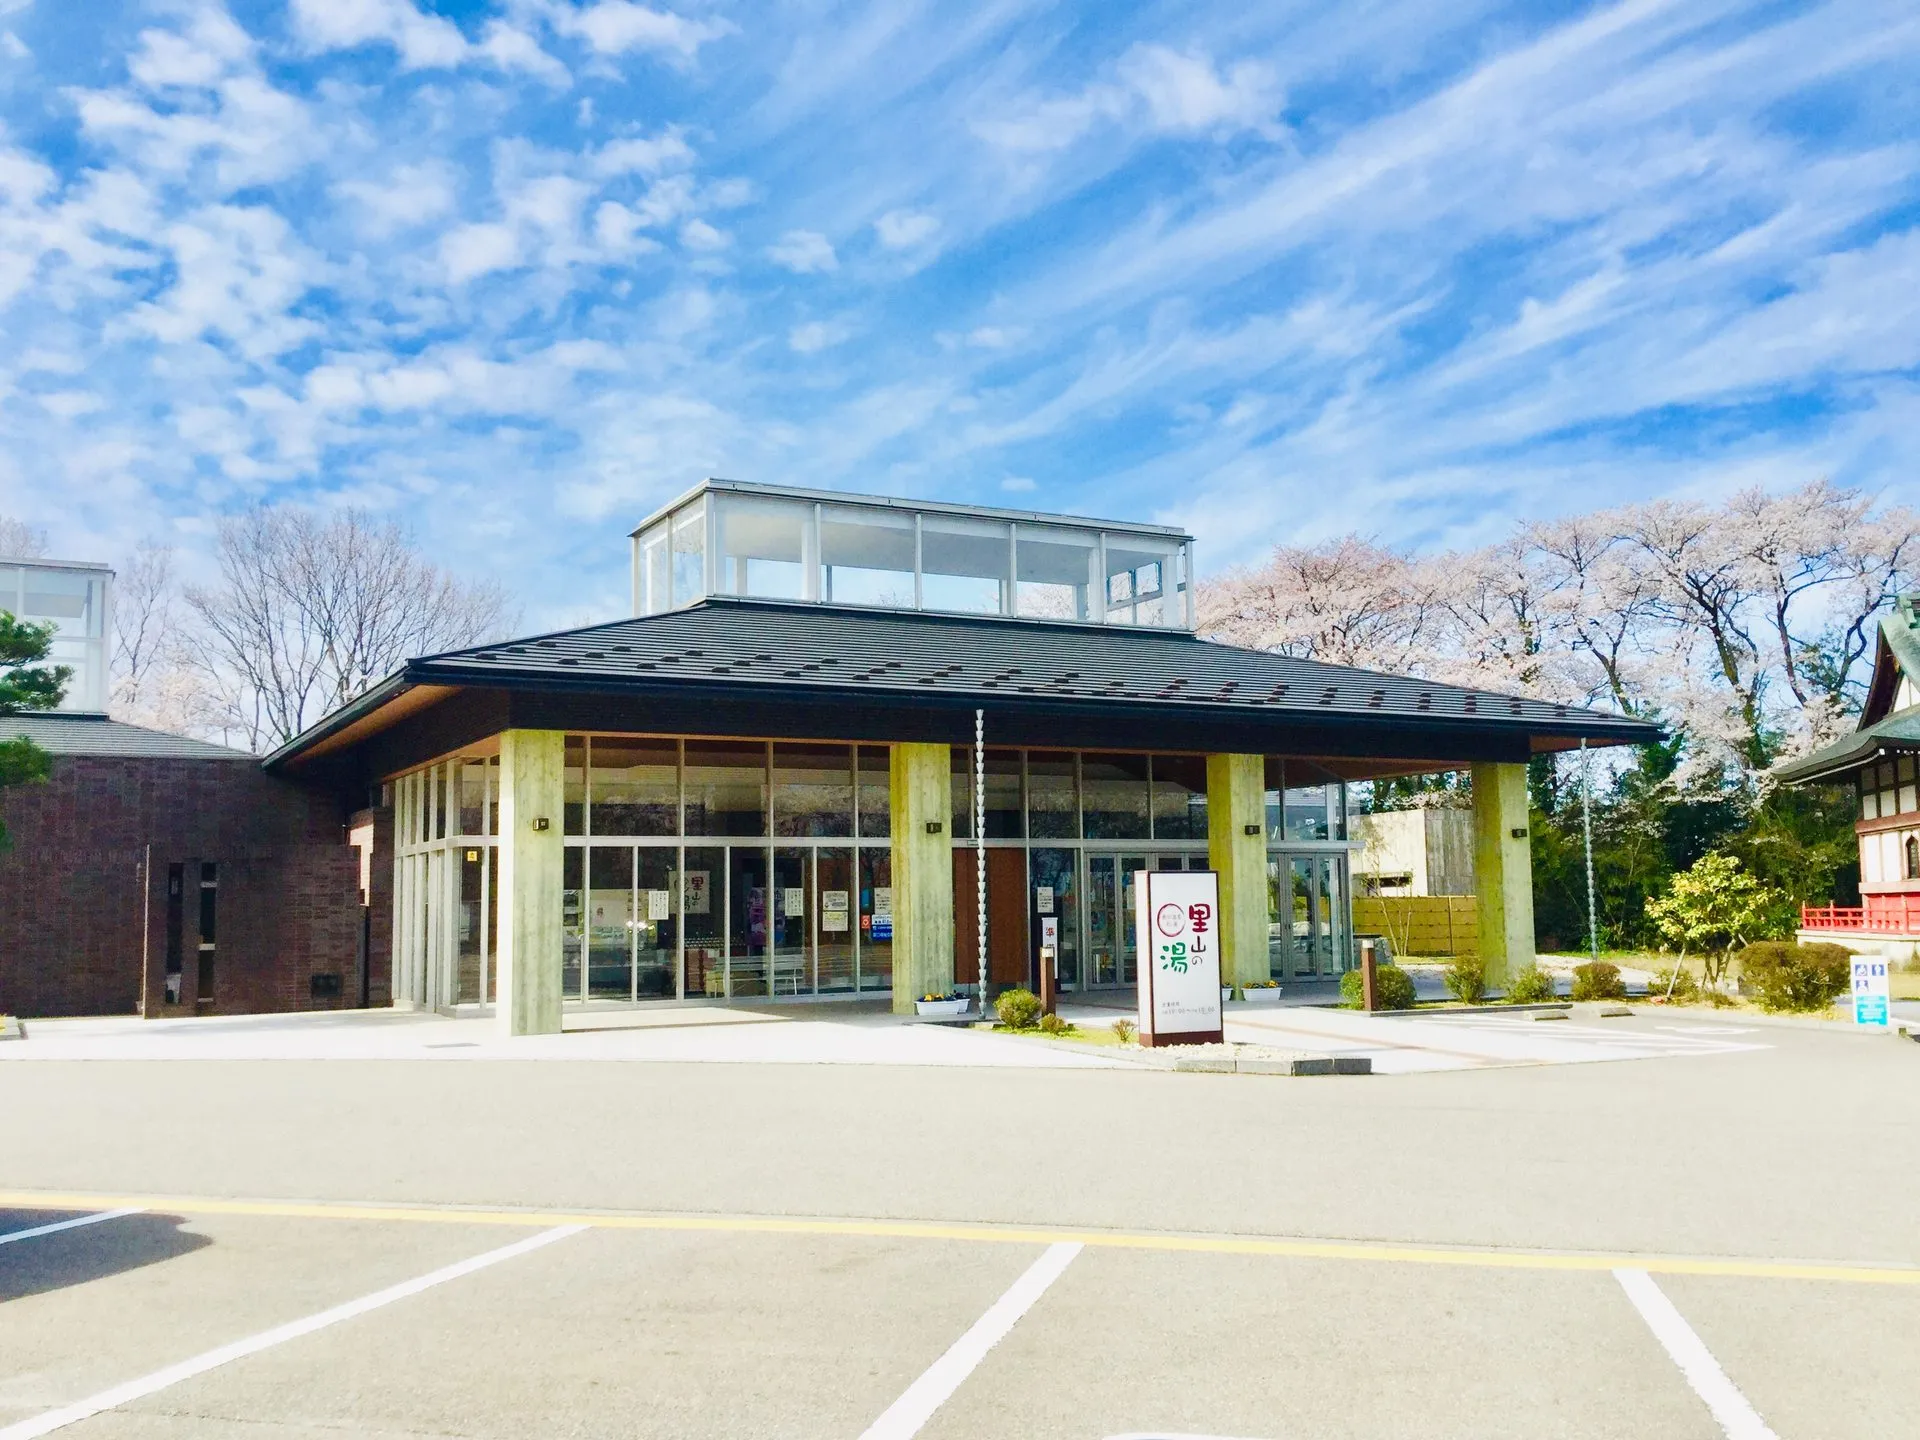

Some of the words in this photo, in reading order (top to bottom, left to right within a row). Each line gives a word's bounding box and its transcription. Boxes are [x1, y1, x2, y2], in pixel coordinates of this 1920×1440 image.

[1160, 942, 1188, 974] 湯
[1188, 903, 1211, 966] 里山の
